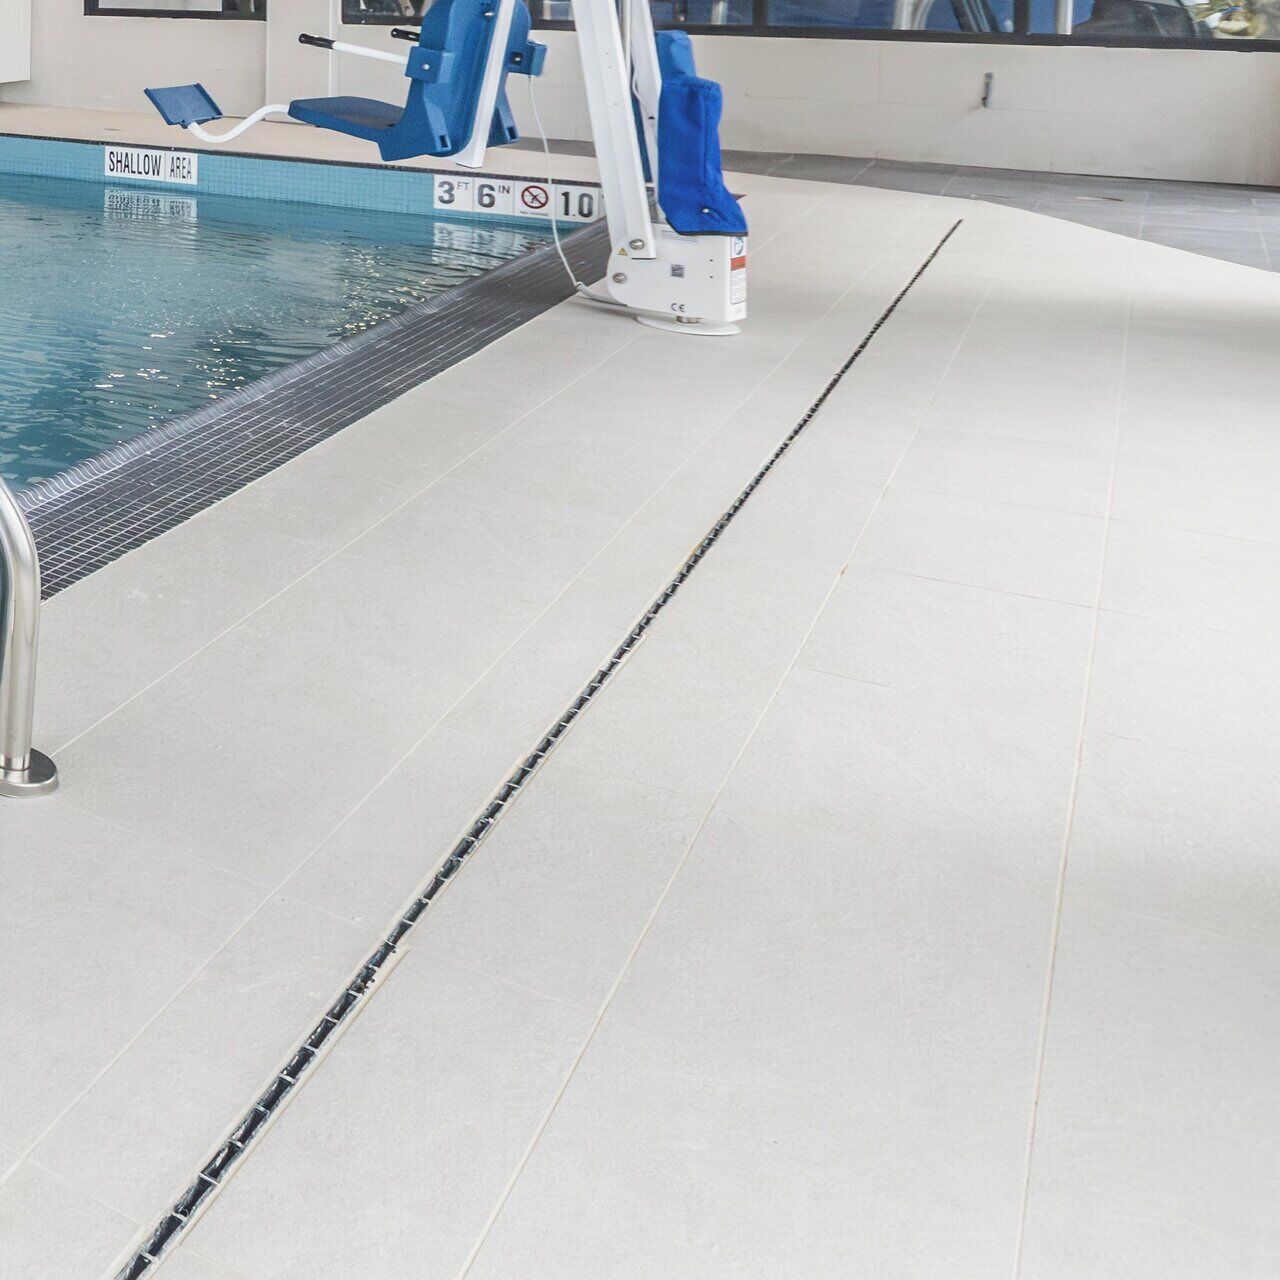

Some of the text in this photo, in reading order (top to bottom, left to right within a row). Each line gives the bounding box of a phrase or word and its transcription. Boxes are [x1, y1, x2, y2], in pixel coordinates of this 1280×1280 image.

[109, 151, 192, 180] SHALLOW AREA
[438, 180, 604, 218] 3 FT 6 IN 1.0
